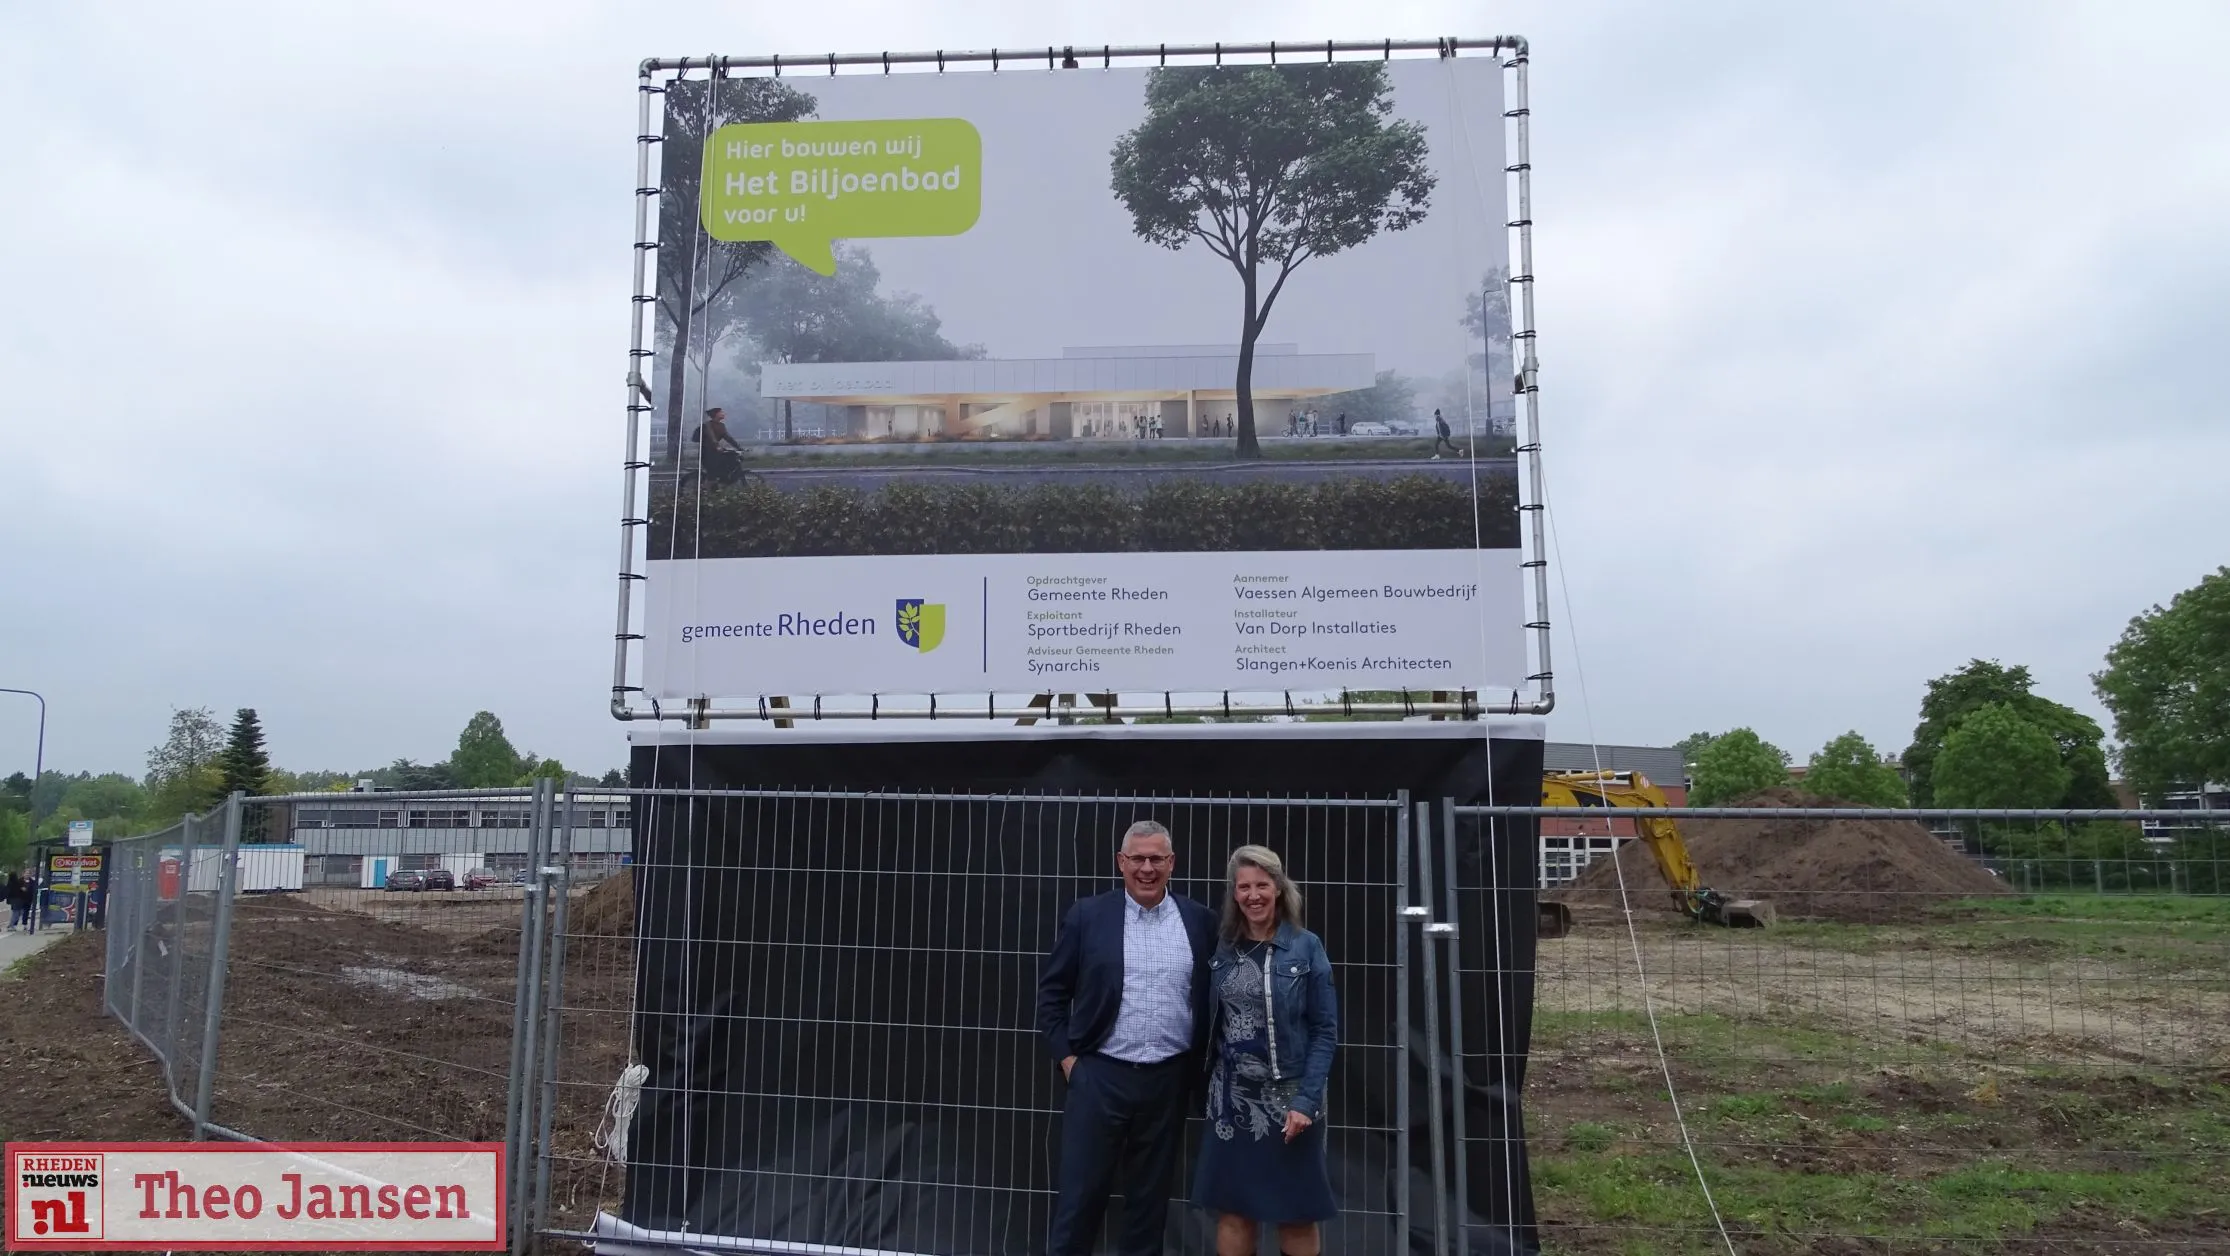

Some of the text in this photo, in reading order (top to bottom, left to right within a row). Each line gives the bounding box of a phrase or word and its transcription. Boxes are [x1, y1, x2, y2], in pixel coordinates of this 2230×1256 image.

[726, 135, 922, 160] Hier bouwen wij
[725, 165, 961, 200] Het Biljoenbad
[724, 204, 806, 224] voor u!
[1027, 576, 1108, 587] Opdrachtgever
[1233, 574, 1289, 583] Aannemer
[1027, 587, 1168, 601] Gemeente Rheden
[1234, 584, 1477, 602] Vaessen Algemeen Bouwbedrijf
[1027, 611, 1083, 621] Exploitant
[1234, 609, 1298, 618] Installateur
[681, 611, 875, 643] gemeente Rheden
[1027, 623, 1181, 640] Sportbedrijf Rheden
[1235, 621, 1397, 637] Van Dorp Installaties
[1027, 645, 1174, 656] Adviseur Gemeente Rheden
[1235, 644, 1287, 654] Architect
[1027, 659, 1101, 675] Synarchis
[1236, 656, 1452, 674] Slangen+Koenis Architecten
[65, 858, 97, 867] Krudvat
